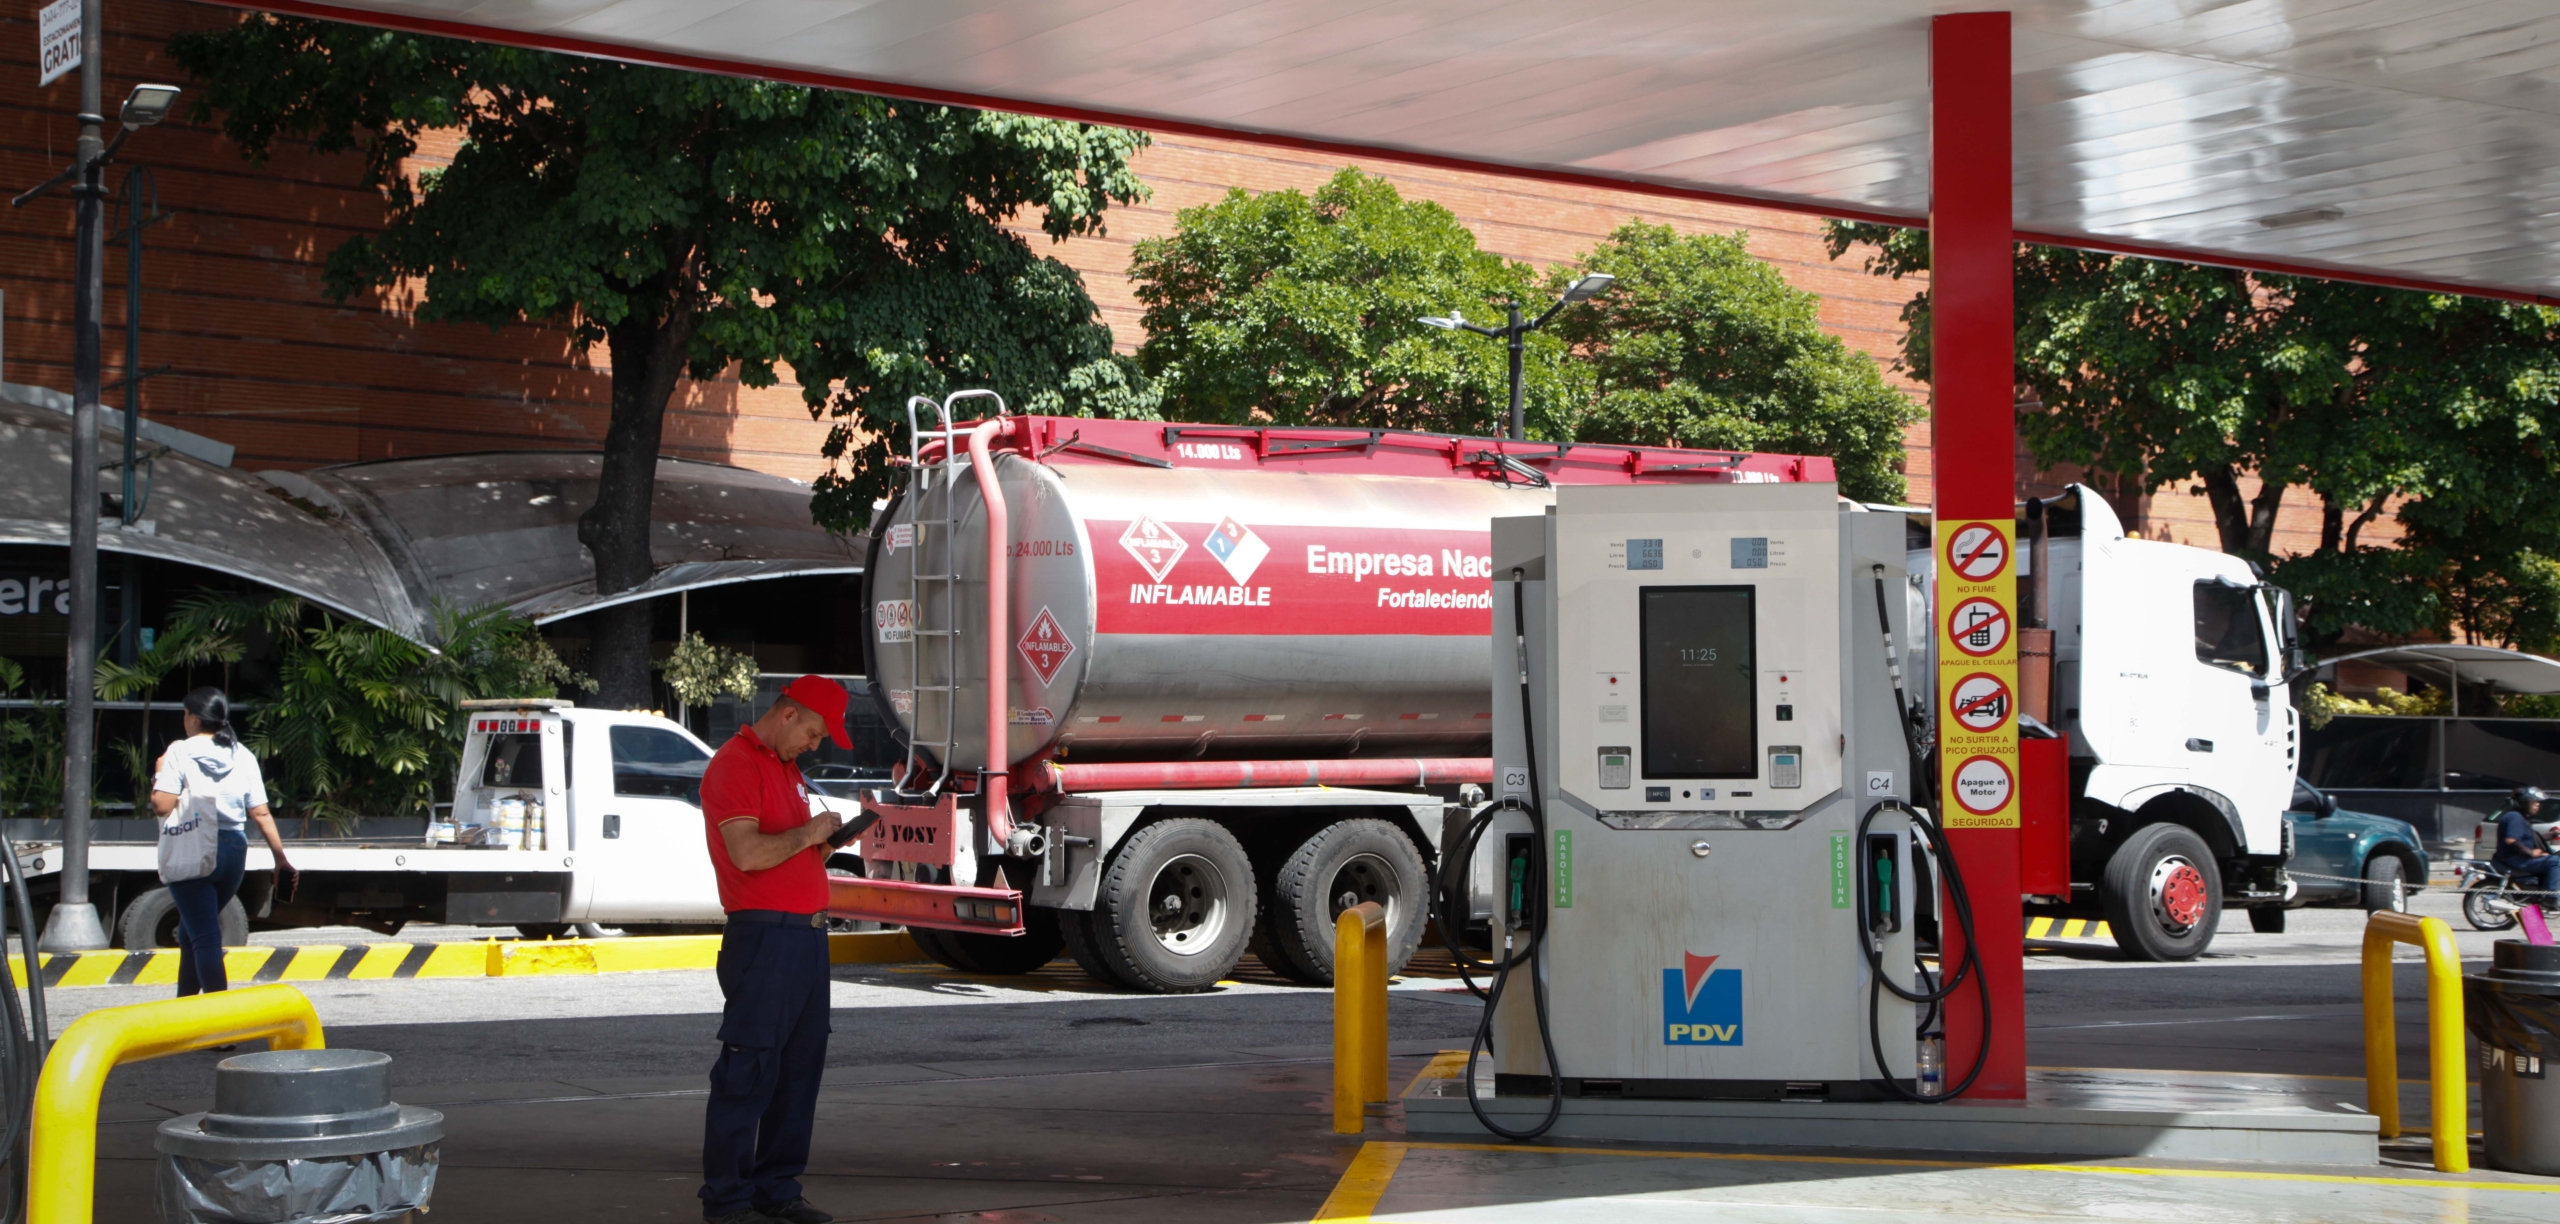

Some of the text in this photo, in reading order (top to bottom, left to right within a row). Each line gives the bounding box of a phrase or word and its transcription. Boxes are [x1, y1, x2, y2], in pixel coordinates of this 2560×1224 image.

[44, 31, 81, 74] GRATI
[1177, 444, 1241, 460] 14.000 Lts
[1227, 523, 1238, 538] 3
[1015, 541, 1052, 557] 24.000
[1055, 540, 1074, 556] Lts
[1129, 537, 1181, 549] INFLAMABLE
[1217, 538, 1225, 553] 1
[1150, 549, 1161, 564] 3
[1307, 544, 1434, 582] Empresa
[1130, 584, 1271, 606] INFLAMABLE
[1972, 585, 1997, 593] FUME
[884, 630, 911, 640] NO FUMAR
[1024, 641, 1067, 653] INFLAMABLE
[1041, 654, 1050, 668] 3
[1680, 648, 1717, 661] 11:25
[1950, 736, 1963, 744] NO
[1966, 736, 2000, 744] SURTIR
[1970, 746, 2016, 754] CRUZADO
[1506, 773, 1526, 786] C3
[1870, 778, 1890, 790] C4
[1960, 779, 1995, 787] Apague
[1952, 818, 2013, 826] SEGURIDAD
[891, 825, 937, 844] YOSY
[1559, 835, 1567, 903] GASOLINA
[1836, 836, 1845, 904] GASOLINA
[1669, 1023, 1738, 1041] PDV
